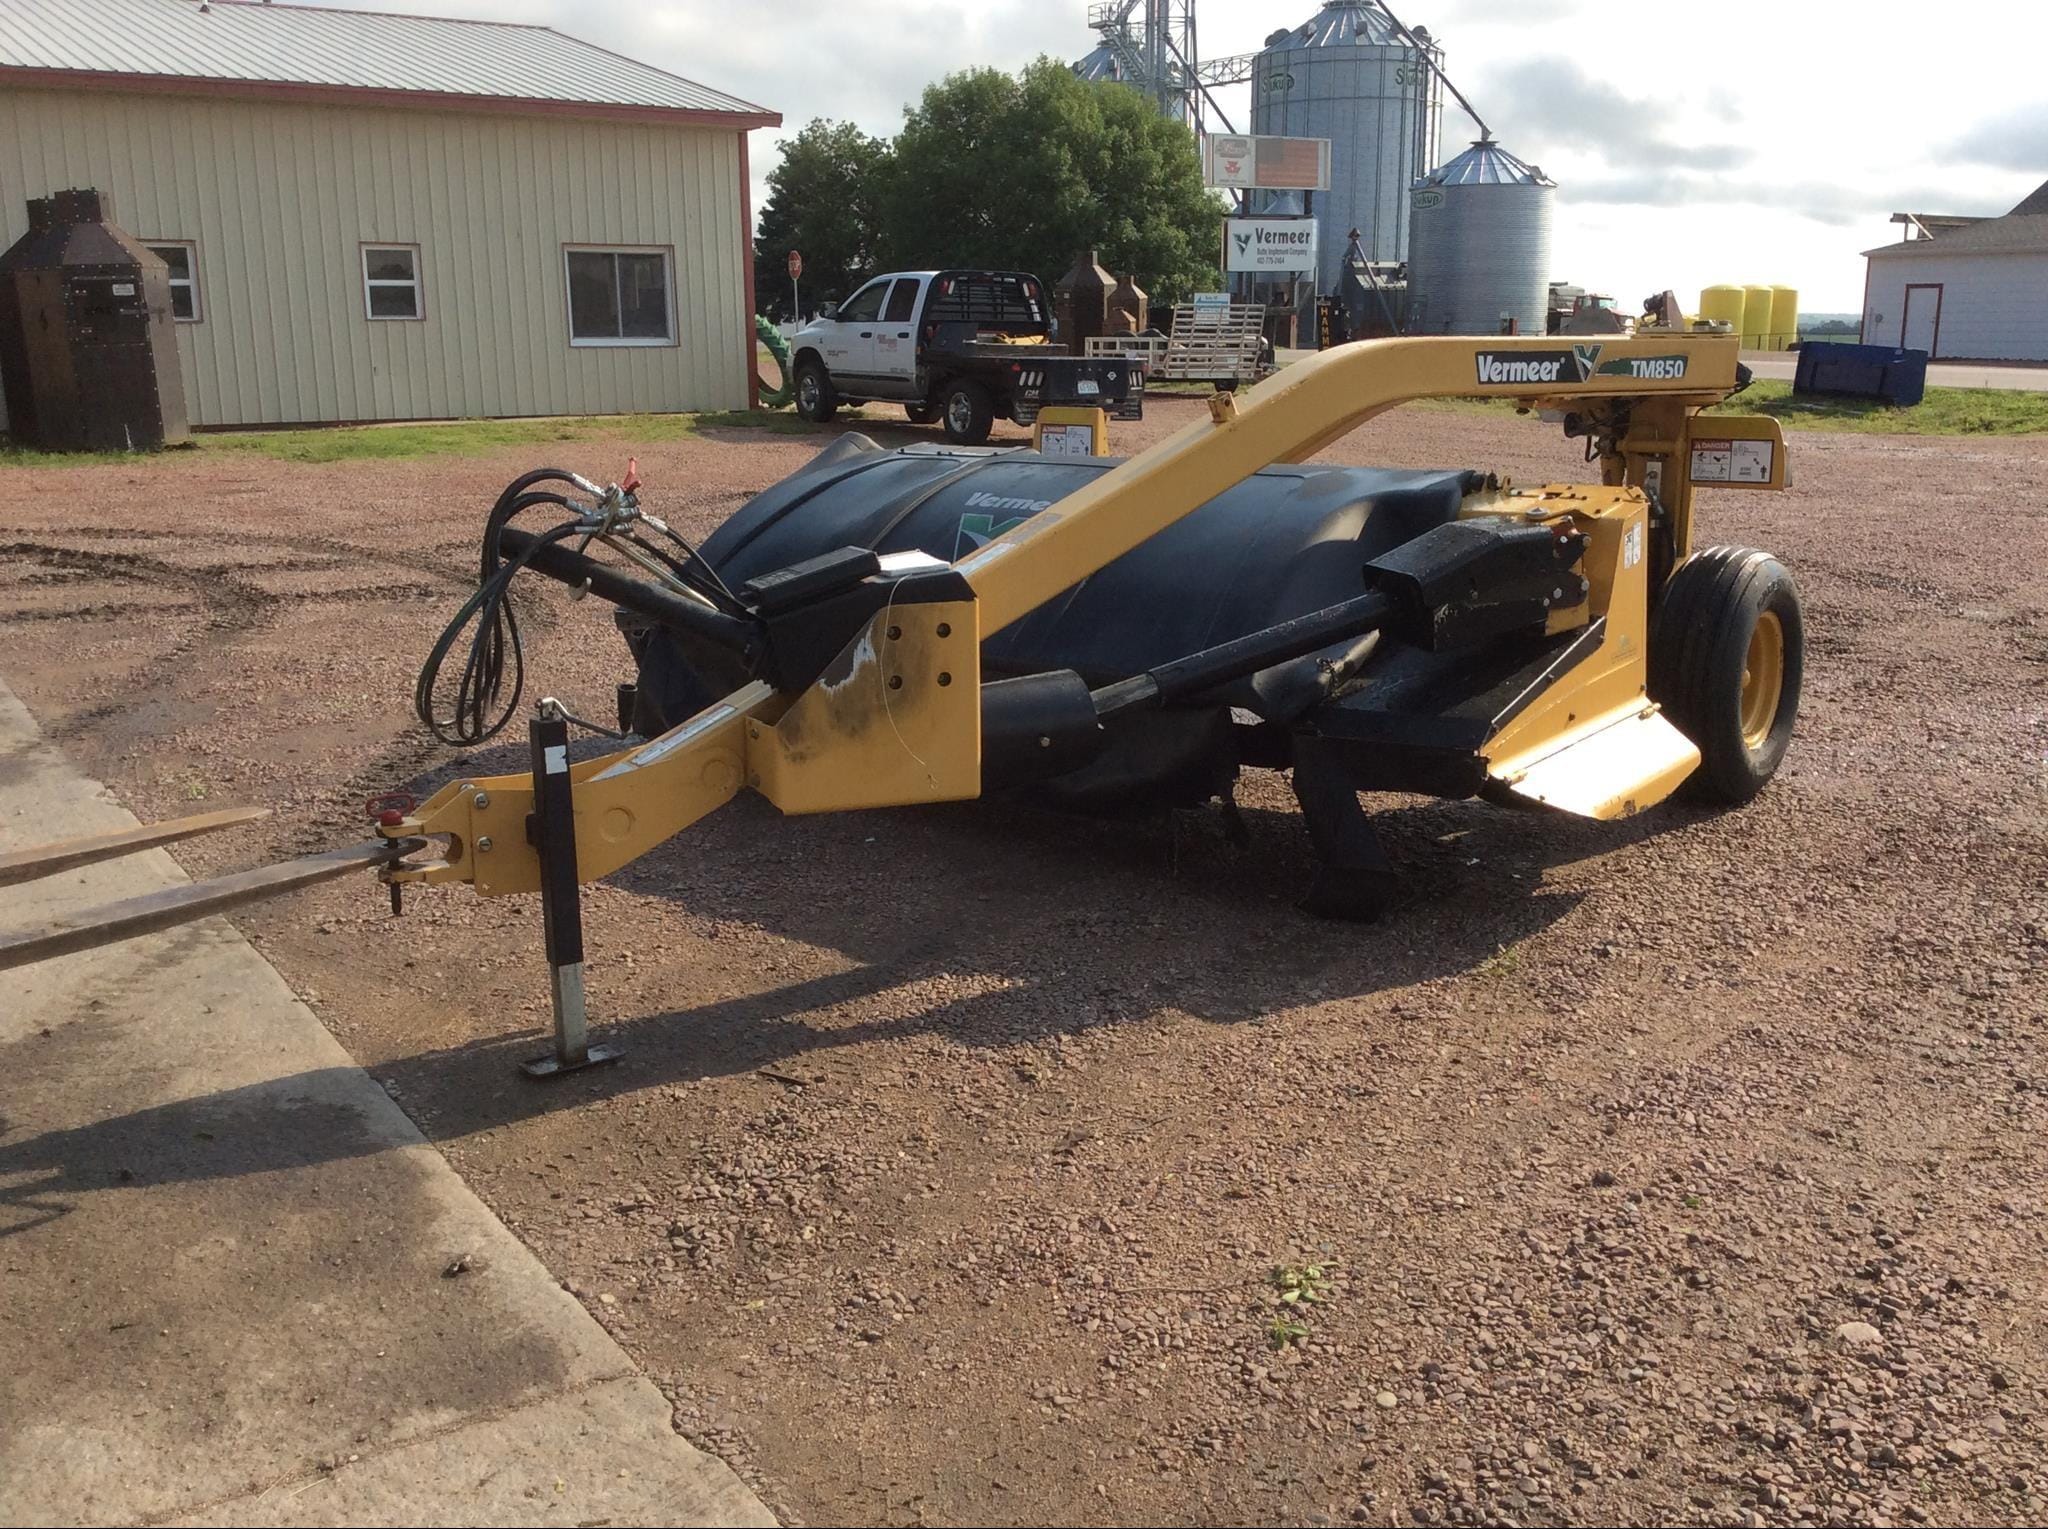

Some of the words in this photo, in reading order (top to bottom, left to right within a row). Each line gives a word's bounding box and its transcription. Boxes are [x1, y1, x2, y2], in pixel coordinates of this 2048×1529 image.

[1255, 227, 1311, 244] Vermeer
[1477, 354, 1561, 382] Vermeer
[1630, 358, 1684, 379] TM850
[1701, 442, 1730, 450] DANGER
[964, 491, 1052, 511] Verme
